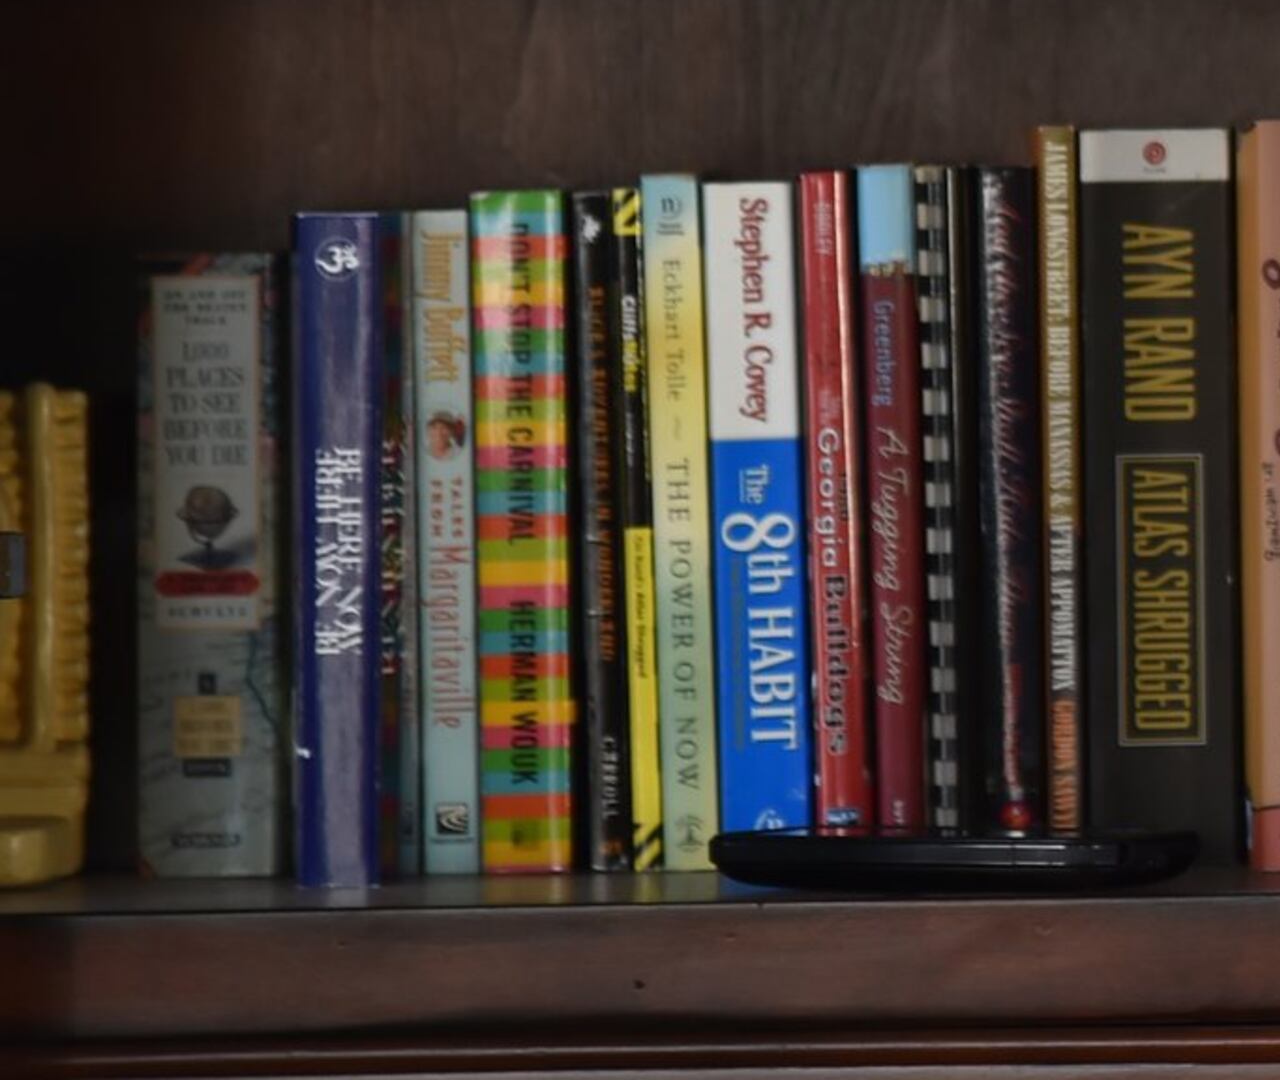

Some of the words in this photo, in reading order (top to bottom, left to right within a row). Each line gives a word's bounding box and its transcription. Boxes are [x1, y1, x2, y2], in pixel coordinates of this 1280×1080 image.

[1044, 141, 1071, 200] JAMES
[412, 230, 466, 303] Jimmy
[509, 223, 531, 293] DON'T
[733, 197, 771, 304] Stephen
[1120, 222, 1197, 299] AYN
[508, 303, 531, 365] STOP
[662, 260, 683, 340] Eckhart
[742, 311, 772, 337] R.
[422, 307, 468, 383] Buffett
[665, 348, 687, 403] Tolle
[738, 345, 774, 423] Covey
[871, 300, 896, 407] Greenberg
[1046, 326, 1073, 397] BEFORE
[1122, 317, 1198, 422] RAND
[169, 393, 198, 414] TO
[202, 392, 241, 413] SEE
[507, 372, 533, 419] THE
[876, 427, 909, 458] A
[1047, 400, 1074, 490] MANASSAS
[507, 427, 535, 545] CARNIVAL
[666, 457, 691, 524] THE
[745, 463, 772, 504] The
[817, 427, 845, 568] Georgia
[1132, 469, 1191, 559] ATLAS
[720, 512, 799, 595] 8th
[872, 468, 910, 591] Tugging
[1049, 513, 1076, 573] AFTER
[669, 539, 695, 651] POWER
[1050, 575, 1078, 690] APPOMATTOX
[419, 545, 474, 730] Margaritaville
[509, 601, 537, 702] HERMAN
[822, 574, 850, 756] Bulldogs
[877, 602, 915, 706] String
[1133, 569, 1193, 730] SHRUGGED
[672, 659, 698, 705] OF
[747, 606, 798, 751] HABIT
[511, 711, 539, 785] WOUK
[675, 715, 702, 790] NOW
